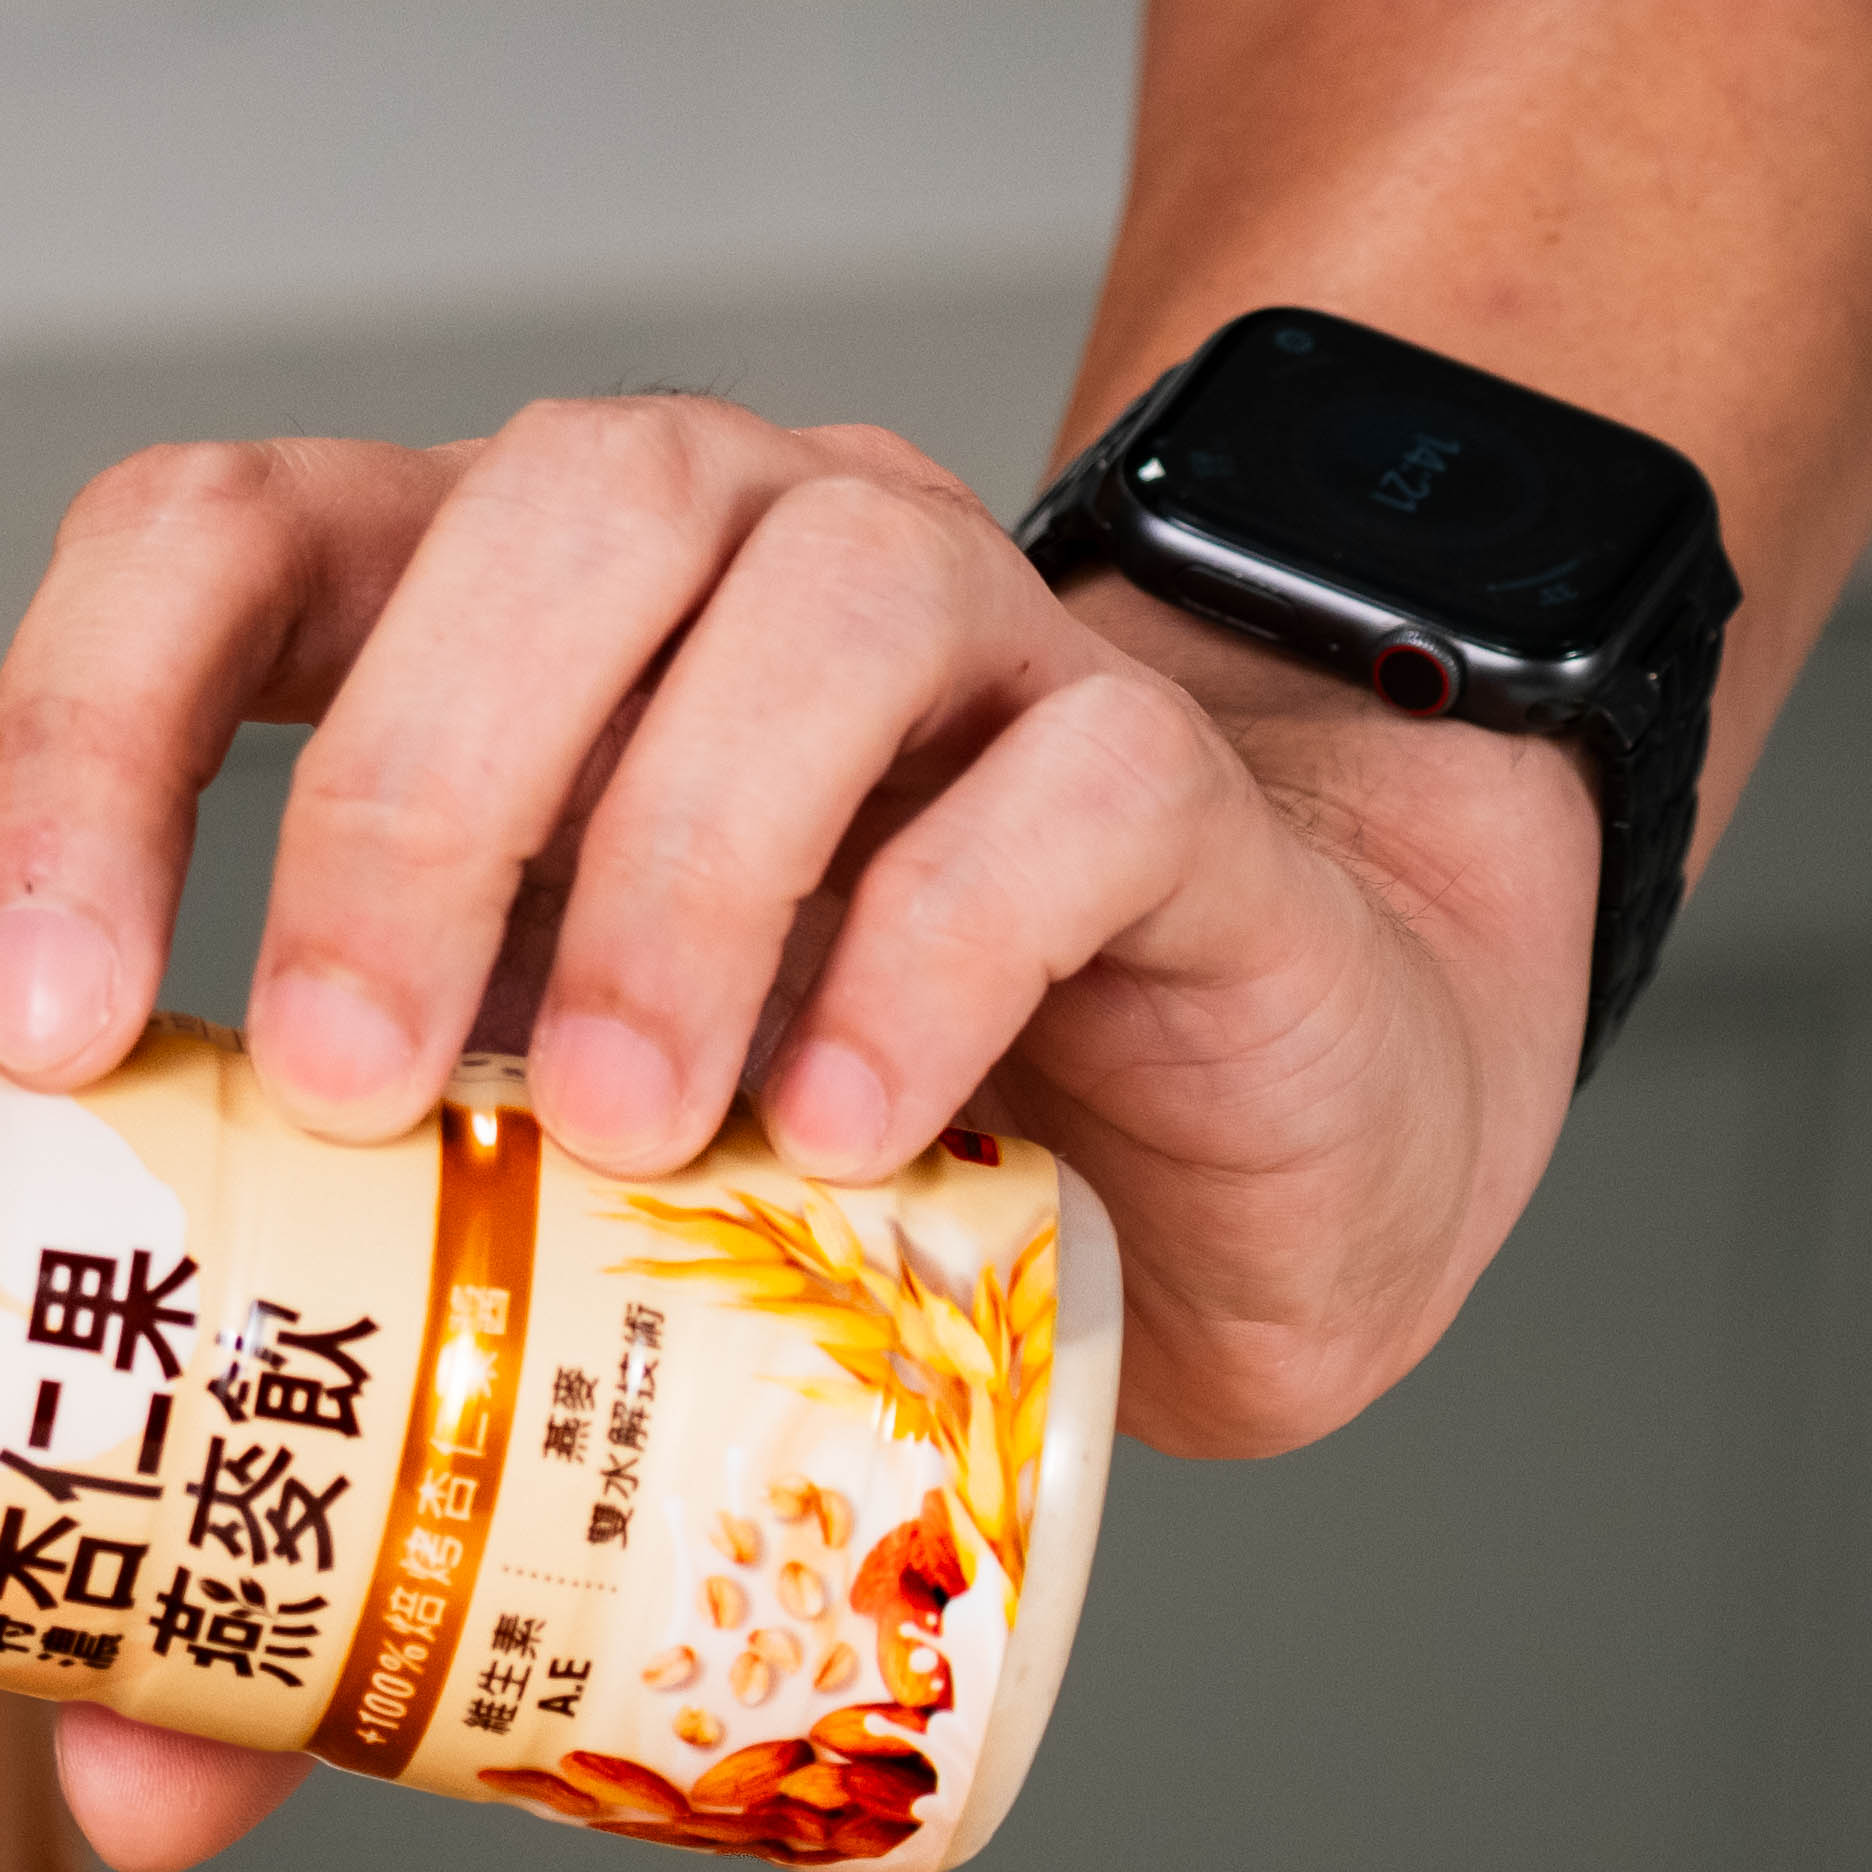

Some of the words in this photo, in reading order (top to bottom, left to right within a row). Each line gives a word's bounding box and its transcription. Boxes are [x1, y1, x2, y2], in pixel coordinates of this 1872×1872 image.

[542, 1365, 599, 1464] 燕麥
[149, 1298, 381, 1687] 燕麥飲
[462, 1613, 546, 1735] 維生素
[537, 1657, 592, 1718] A.E
